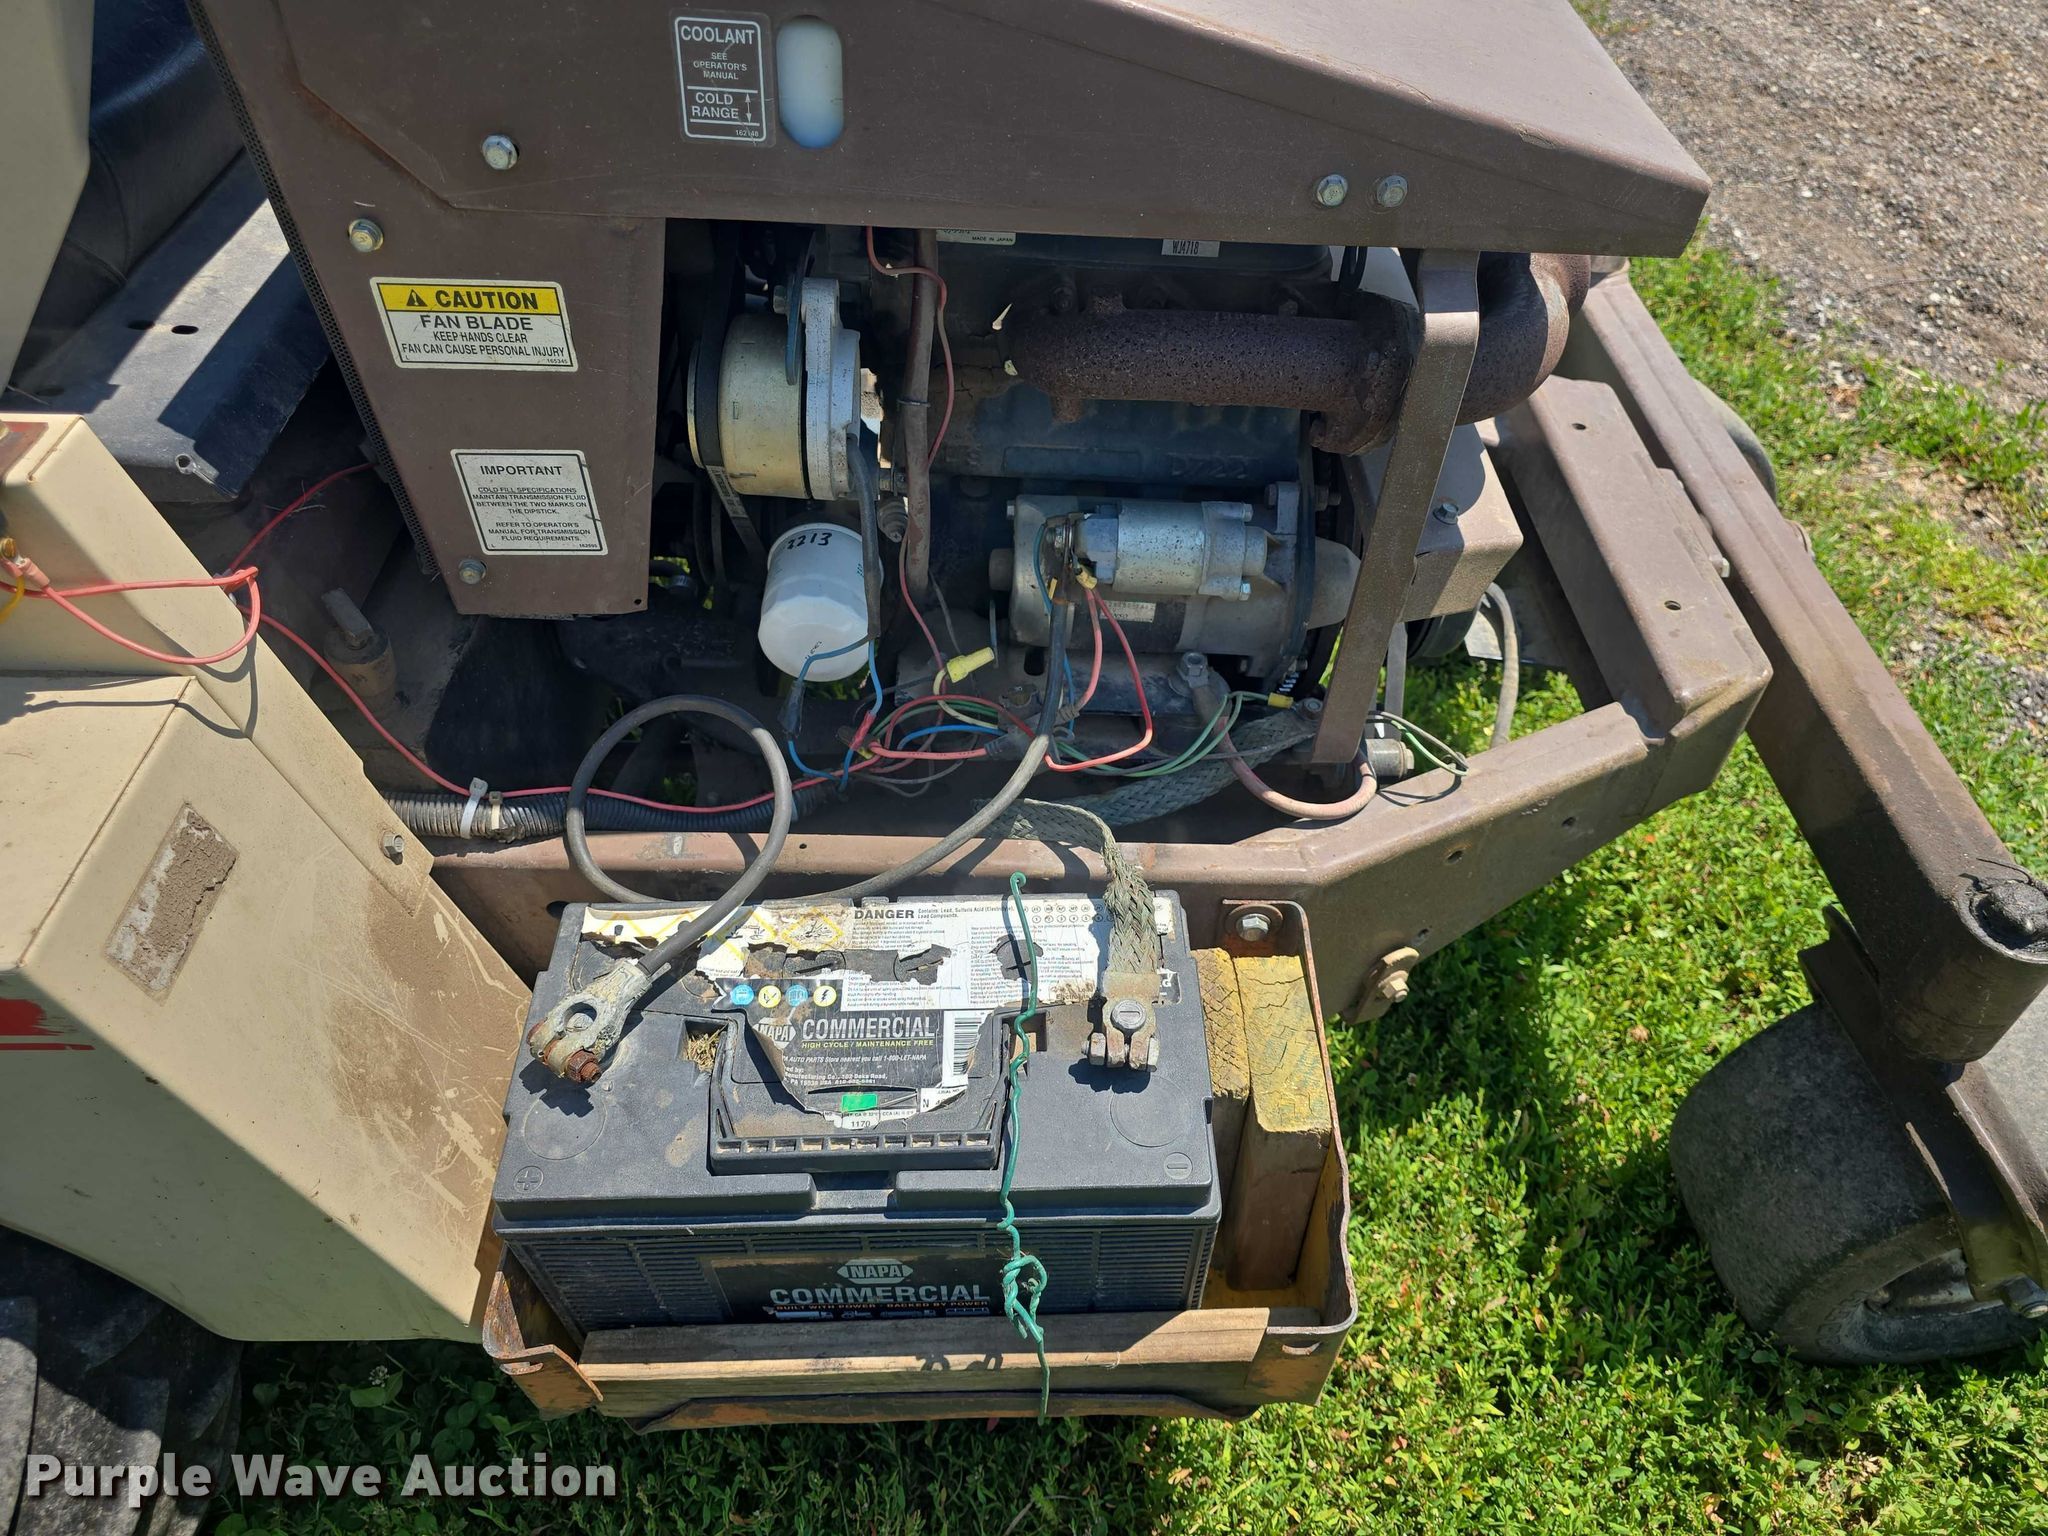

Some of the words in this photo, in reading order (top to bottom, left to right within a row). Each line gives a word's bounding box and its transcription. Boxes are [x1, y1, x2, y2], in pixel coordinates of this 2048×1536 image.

[680, 25, 755, 45] COOLANT
[711, 52, 728, 61] SEE
[693, 61, 748, 71] OPERATOR'S
[703, 70, 739, 80] MANUAL
[695, 92, 733, 105] COLD
[691, 106, 739, 119] RANGE
[435, 289, 539, 310] CAUTION
[420, 315, 461, 329] FAN
[466, 316, 534, 331] BLADE
[433, 331, 458, 342] KEEP
[460, 332, 494, 343] HANDS
[496, 333, 528, 344] CLEAR
[402, 343, 421, 354] FAN
[423, 344, 443, 354] CAN
[445, 344, 477, 355] CAUSE
[479, 345, 531, 356] PERSONAL
[532, 346, 565, 357] INJURY
[480, 465, 563, 476] IMPORTANT
[854, 909, 915, 919] DANGER
[760, 1024, 789, 1041] NAPA
[802, 1017, 935, 1040] COMMERCIAL
[801, 1041, 821, 1049] HIGH
[855, 1040, 912, 1048] MAINTENANCE
[850, 1264, 899, 1279] NAPA
[769, 1284, 990, 1305] COMMERCIAL
